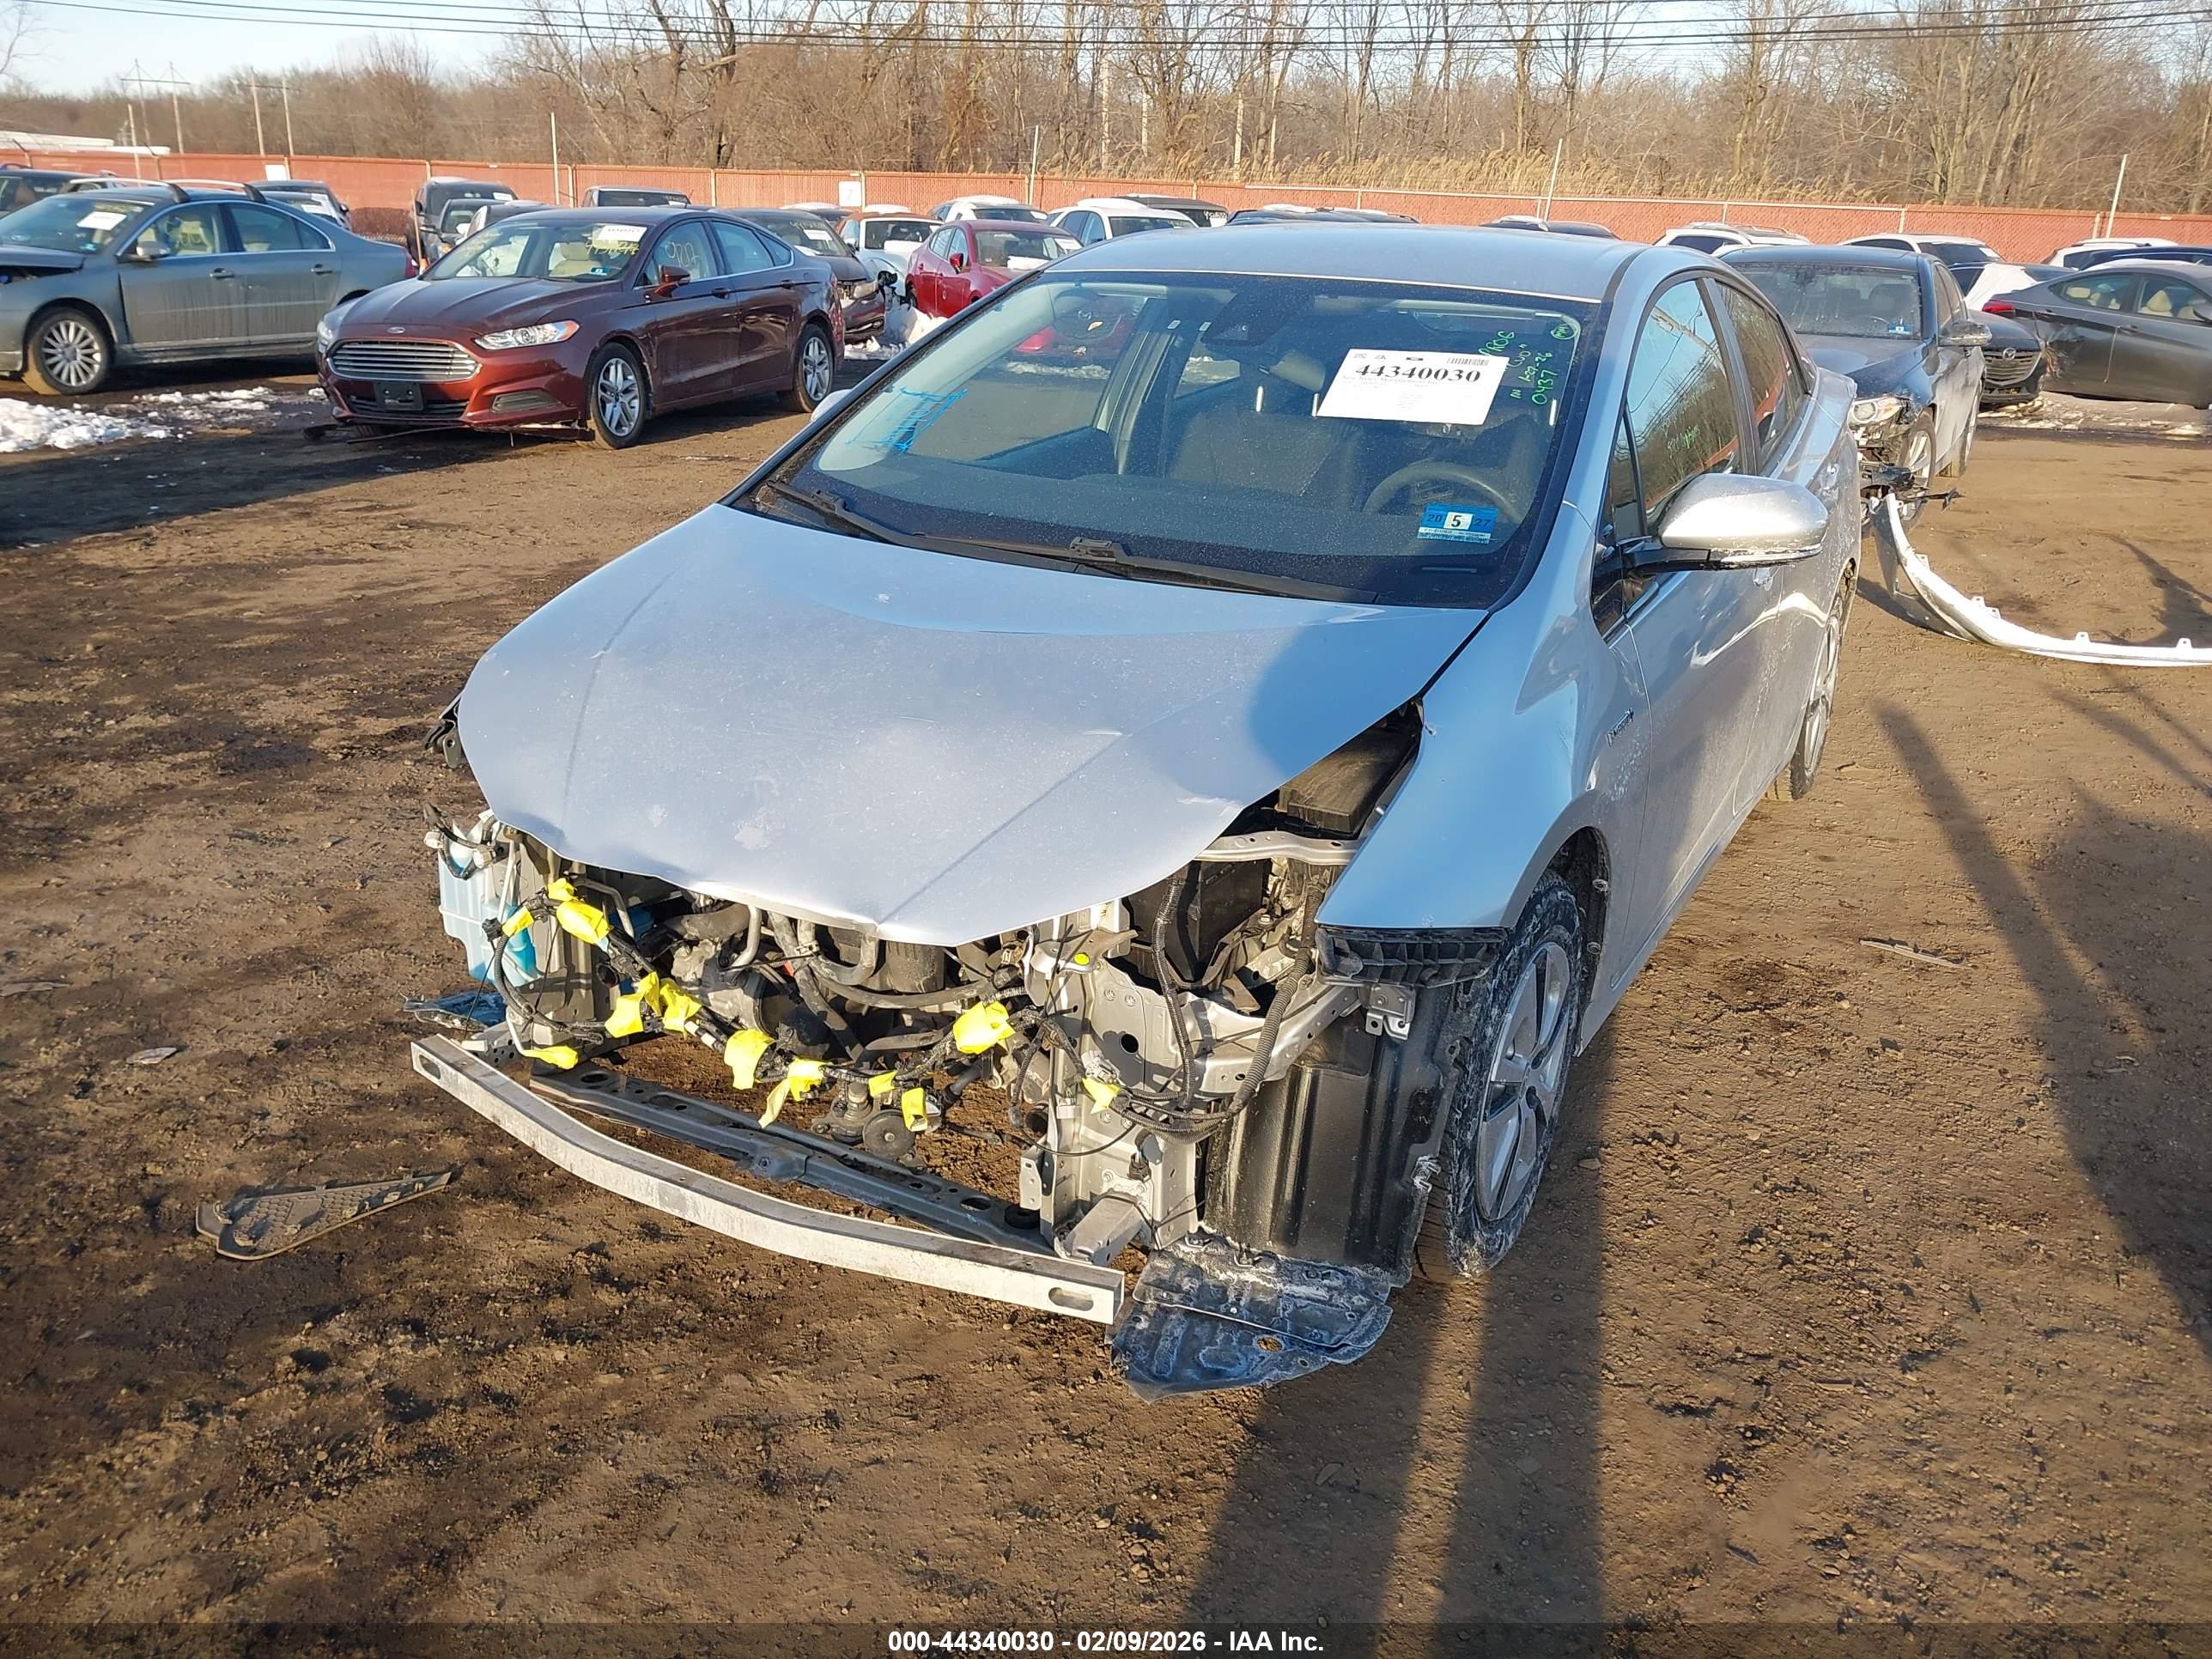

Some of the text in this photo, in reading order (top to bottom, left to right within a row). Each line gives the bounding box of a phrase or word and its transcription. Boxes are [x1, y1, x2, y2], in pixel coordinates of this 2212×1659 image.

[1355, 364, 1481, 383] 44340030
[1532, 370, 1559, 404] 0437
[1427, 514, 1492, 527] 20 5 27
